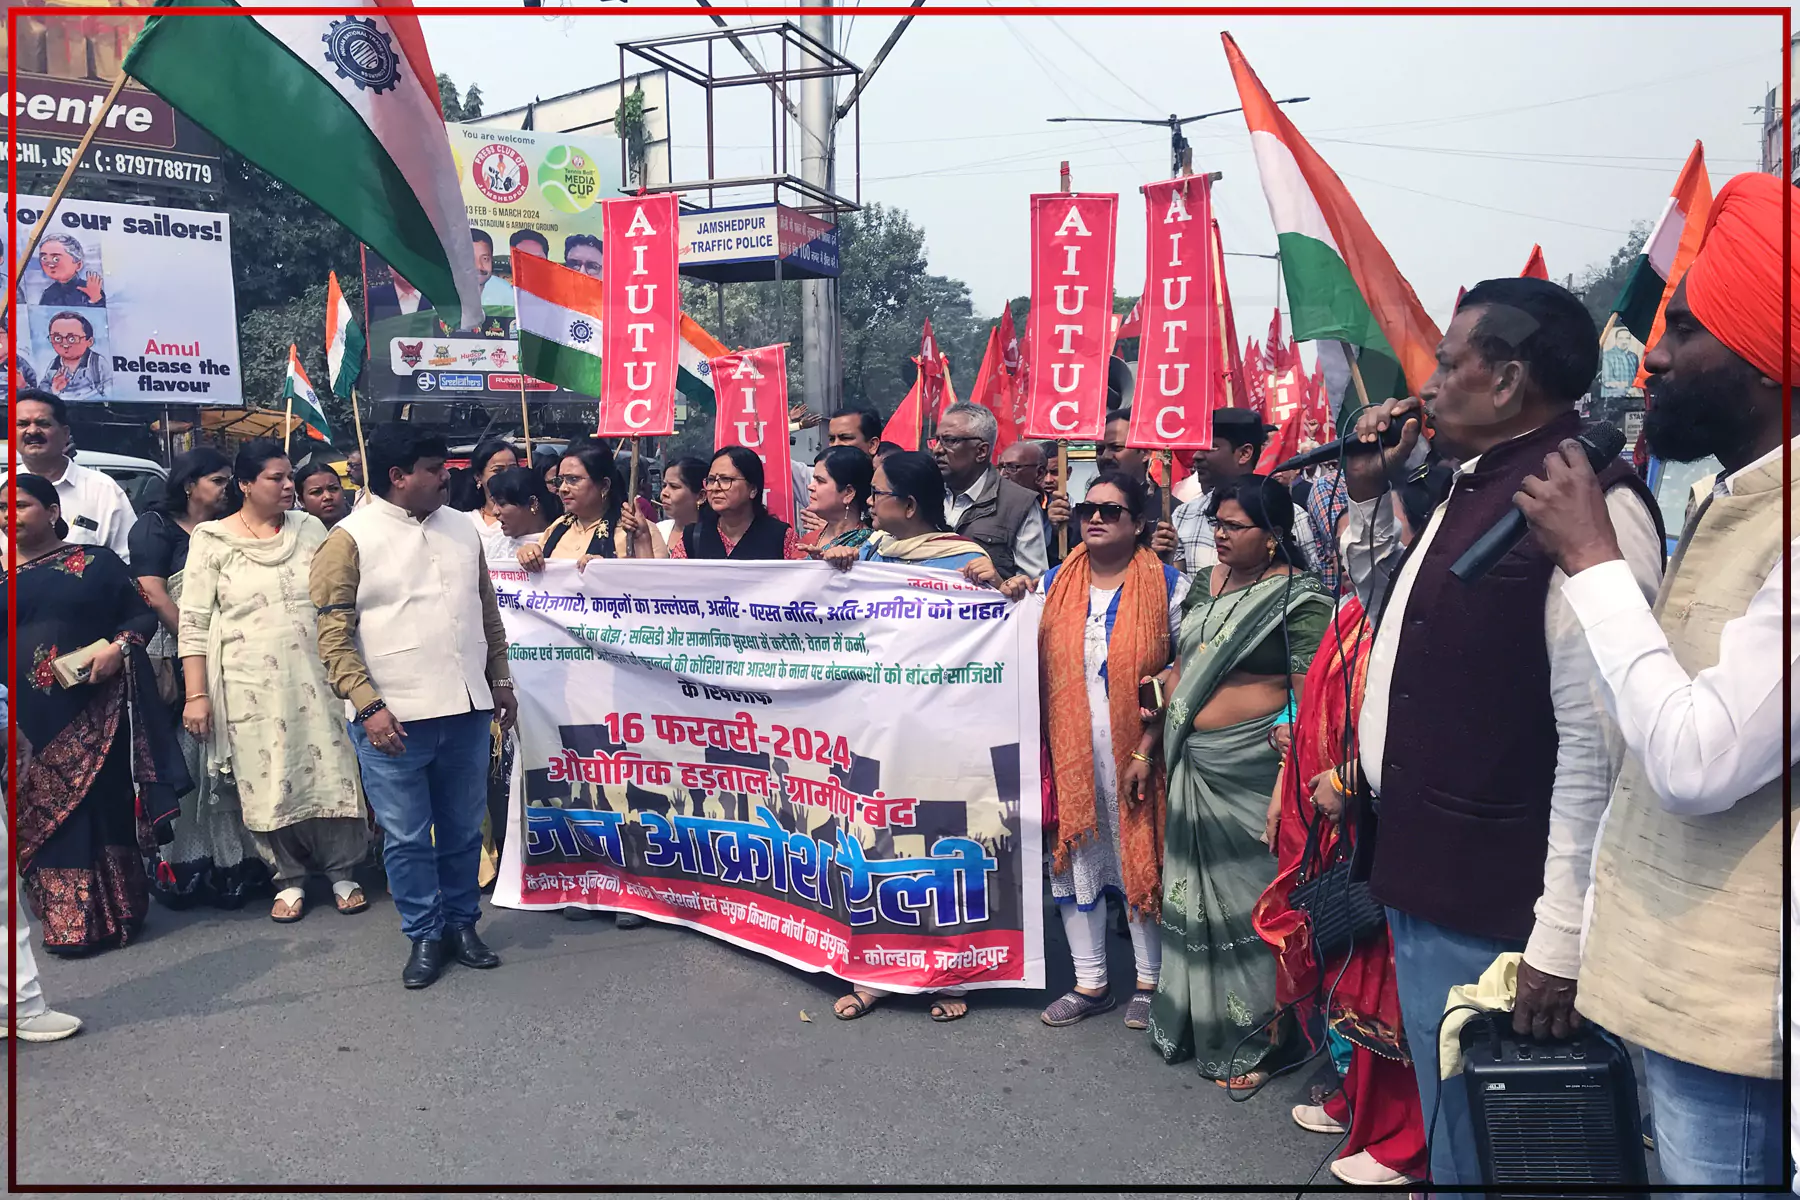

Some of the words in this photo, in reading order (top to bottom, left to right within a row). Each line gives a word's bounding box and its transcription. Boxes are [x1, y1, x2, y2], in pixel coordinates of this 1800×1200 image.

[343, 30, 368, 41] NATIONAL
[0, 91, 153, 132] centre
[462, 130, 478, 139] You
[497, 134, 536, 144] welcome
[475, 145, 496, 164] PRESS
[496, 145, 516, 158] CLUB
[516, 156, 526, 167] OF
[116, 154, 212, 184] 8797788779
[564, 174, 596, 185] MEDIA
[477, 183, 526, 202] JAMSHEDPUR
[568, 184, 594, 196] CUP
[474, 206, 487, 216] FEB
[492, 207, 498, 216] 6
[498, 207, 522, 218] MARCH
[522, 209, 540, 220] 2024
[60, 210, 112, 232] our
[123, 212, 224, 242] sailors!
[480, 218, 504, 228] STADIUM
[536, 222, 558, 232] GROUND
[696, 216, 766, 236] JAMSHEDPUR
[691, 238, 733, 254] TRAFFIC
[736, 234, 772, 250] POLICE
[799, 242, 810, 260] 100
[623, 206, 658, 428] AIUTUC
[1050, 204, 1092, 432] AIUTUC
[1154, 190, 1192, 440] AIUTUC
[144, 338, 200, 356] Amul
[112, 356, 192, 374] Release
[198, 358, 230, 376] the
[138, 374, 210, 392] flavour
[500, 568, 530, 582] बचाओ!
[496, 586, 525, 611] हँगाई,
[526, 590, 589, 615] बेरोज़गारी,
[590, 593, 632, 620] कानूनों
[632, 598, 650, 614] का
[650, 594, 706, 620] उल्लंघन,
[706, 595, 740, 618] अमीर
[748, 603, 782, 622] परस्त
[782, 600, 824, 624] नीति,
[928, 598, 954, 620] को
[958, 600, 1011, 622] राहत,
[586, 626, 598, 642] का
[600, 624, 622, 644] बोझ
[628, 625, 665, 646] सब्सिडी
[666, 626, 685, 646] और
[686, 628, 732, 648] सामाजिक
[731, 634, 760, 654] सुरक्षा
[758, 632, 771, 651] में
[768, 632, 806, 654] कटौती;
[805, 632, 830, 652] वेतन
[831, 631, 843, 652] में
[844, 632, 870, 656] कमी,
[538, 643, 553, 660] एवं
[674, 654, 690, 673] की
[690, 654, 724, 676] कोशिश
[725, 660, 746, 676] तथा
[746, 661, 778, 678] आस्था
[778, 658, 788, 679] के
[788, 664, 810, 680] नाम
[810, 664, 824, 681] पर
[825, 660, 884, 684] मेहनतकशों
[884, 662, 902, 685] को
[904, 663, 948, 686] बांटने
[948, 661, 1006, 685] साजिशों
[676, 677, 699, 698] के
[604, 712, 646, 744] 16
[651, 711, 850, 771] फरवरी-2024
[548, 749, 673, 786] औद्योगिक
[782, 774, 859, 823] ग्रामीण
[860, 790, 918, 828] बंद
[527, 805, 626, 868] जन
[640, 806, 834, 908] आक्रोश
[835, 826, 998, 928] रैली
[526, 872, 558, 890] केंद्रीय
[558, 872, 577, 892] ट्रेड
[701, 894, 718, 914] एवं
[718, 896, 748, 925] संयुक्त
[747, 902, 780, 933] किसान
[780, 914, 804, 942] मोर्चा
[804, 925, 818, 948] का
[862, 944, 930, 972] कोल्हान,
[932, 944, 1010, 971] जमशेदपुर
